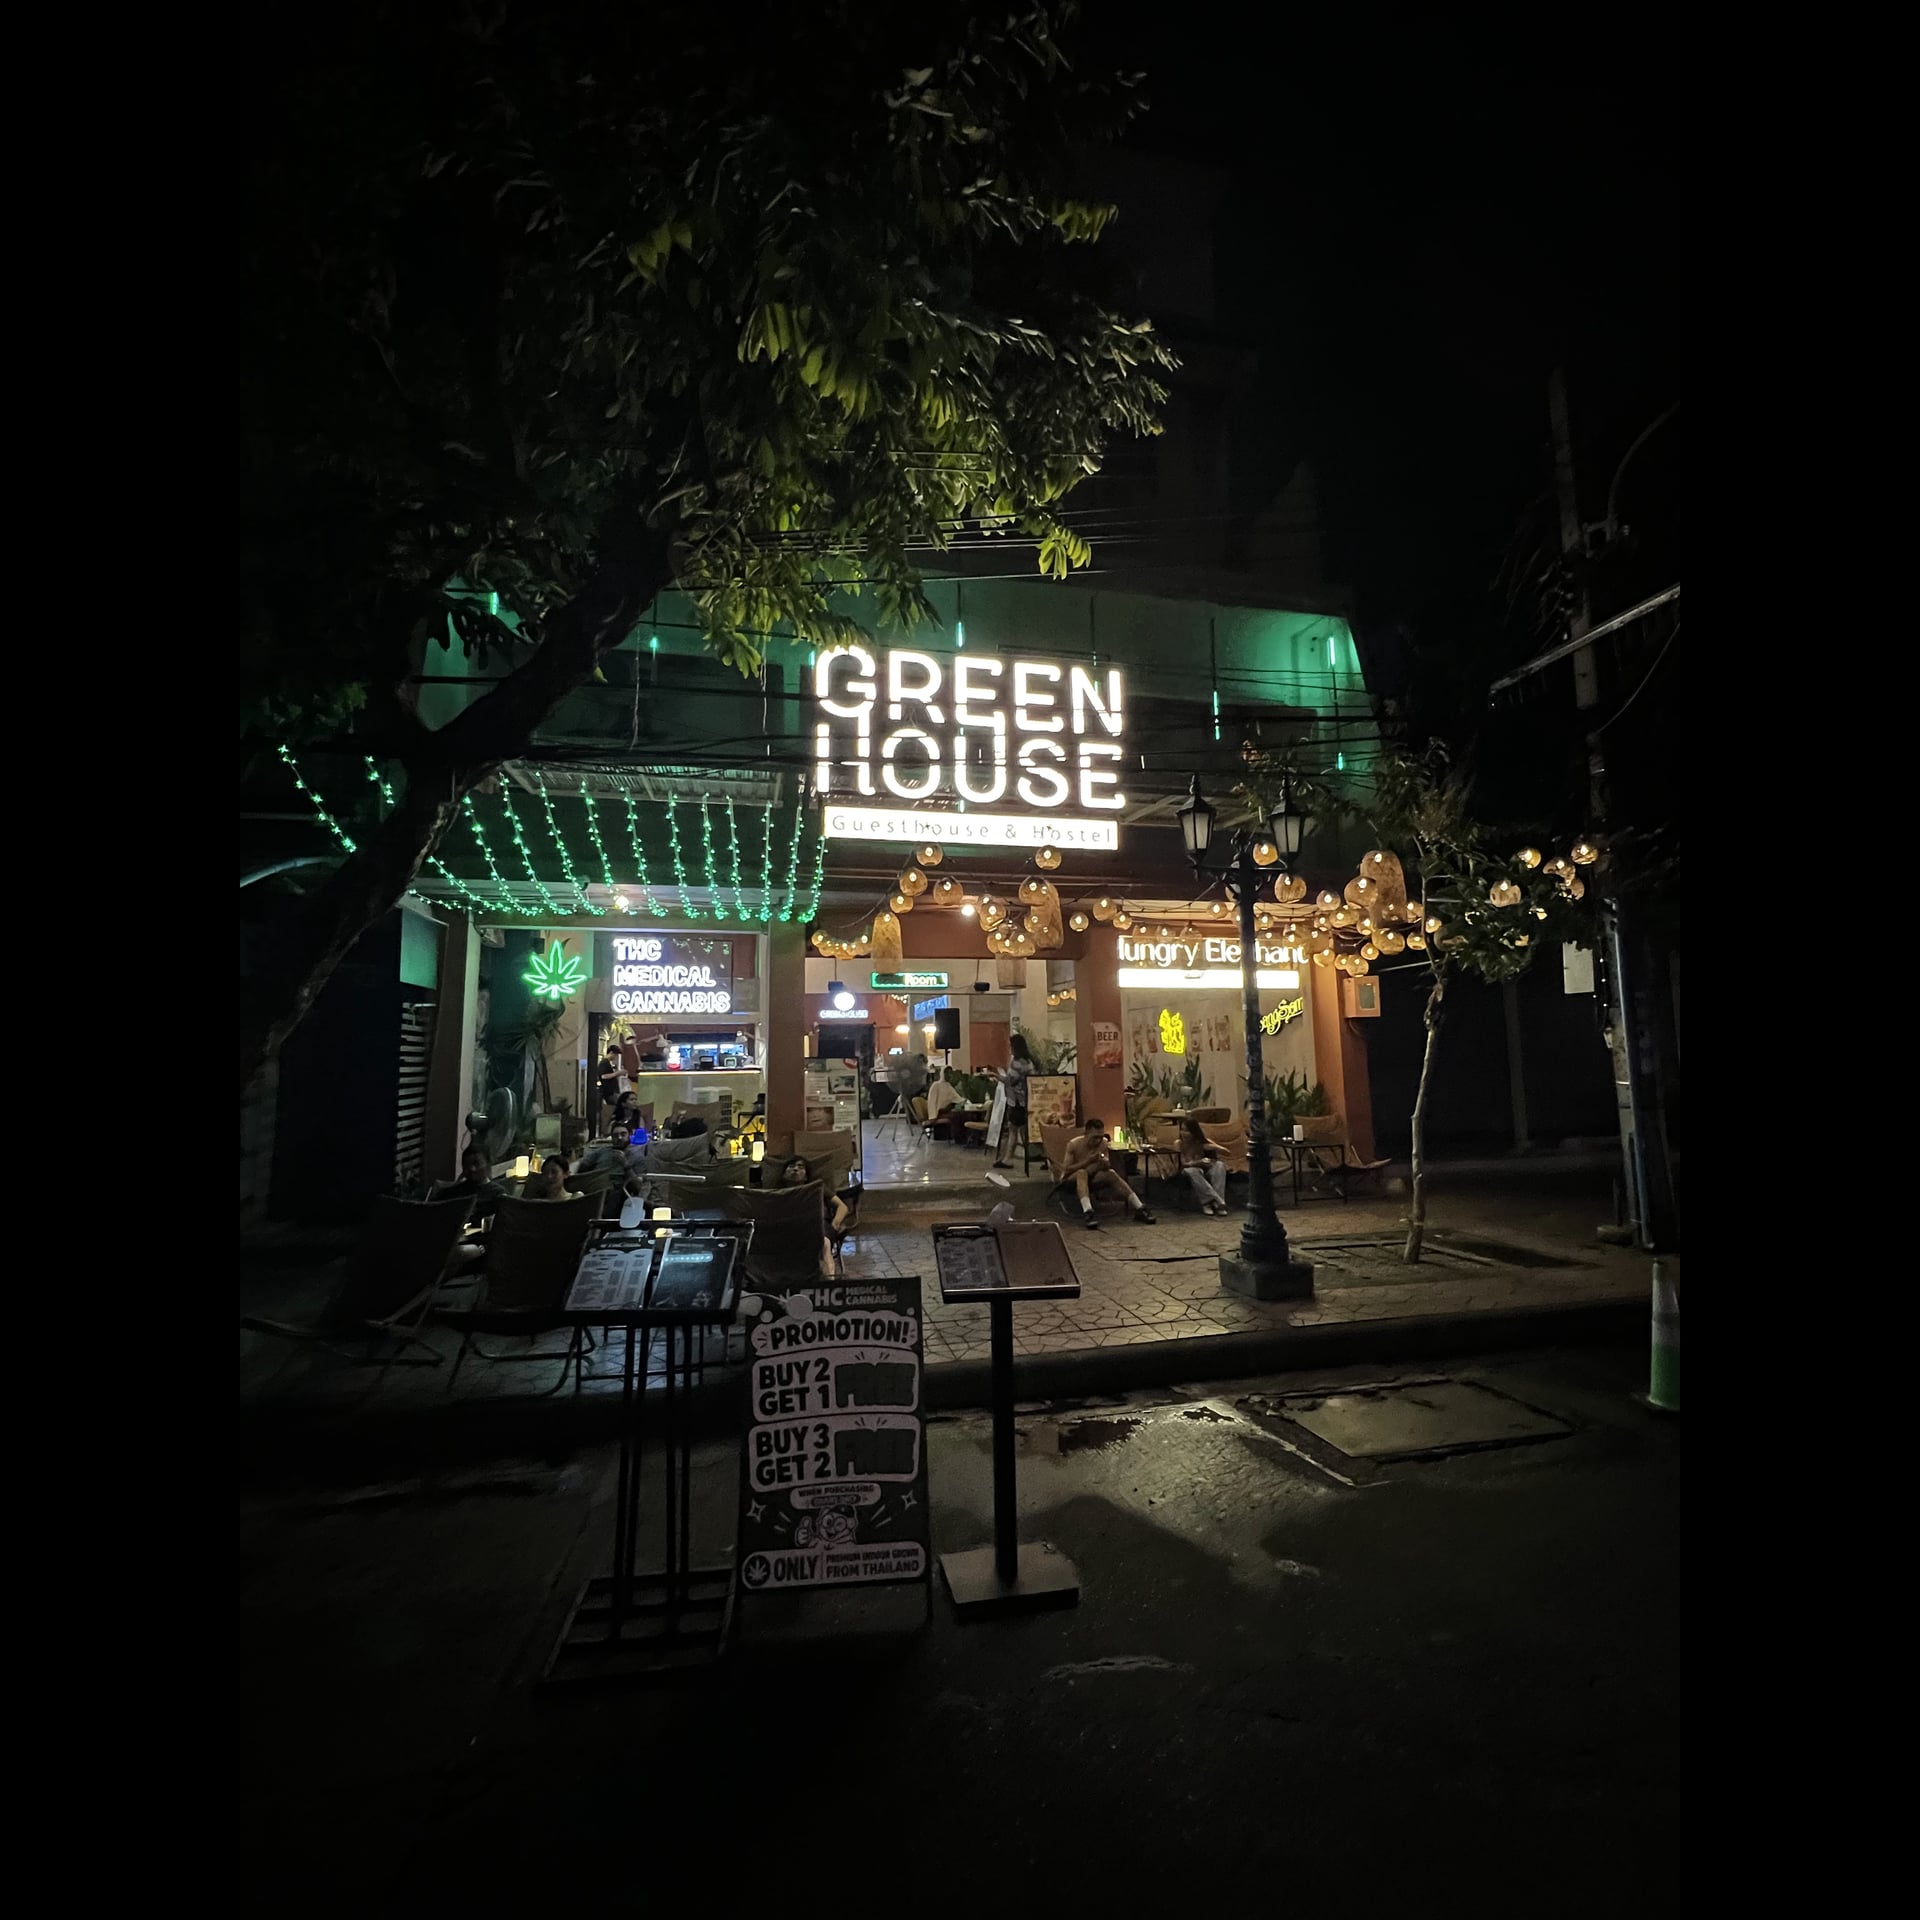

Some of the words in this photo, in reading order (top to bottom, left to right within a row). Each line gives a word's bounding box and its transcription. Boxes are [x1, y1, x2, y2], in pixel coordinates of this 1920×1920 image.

[815, 645, 1122, 735] GREEN
[816, 723, 1125, 809] HOUSE
[831, 814, 989, 838] Guesthouse
[1005, 823, 1017, 839] &
[1033, 820, 1111, 843] Hostel
[613, 938, 662, 961] THC
[1204, 937, 1309, 964] Elehant
[613, 964, 716, 987] MEDICAL
[904, 974, 938, 986] Room
[612, 991, 731, 1013] CANNABIS
[1097, 1031, 1119, 1041] BEER
[845, 1285, 888, 1296] MEDICAL
[845, 1294, 898, 1305] CANNABIS
[770, 1318, 910, 1350] PROMOTION!
[759, 1360, 811, 1389] BUY
[814, 1357, 830, 1382] 2
[759, 1387, 810, 1415] GET
[818, 1385, 830, 1408] 1
[756, 1426, 809, 1457] BUY
[814, 1423, 830, 1449] 3
[756, 1454, 809, 1486] GET
[814, 1452, 831, 1478] 2
[774, 1555, 818, 1581] ONLY
[826, 1564, 860, 1578] FROM
[863, 1560, 920, 1575] THAILAND
